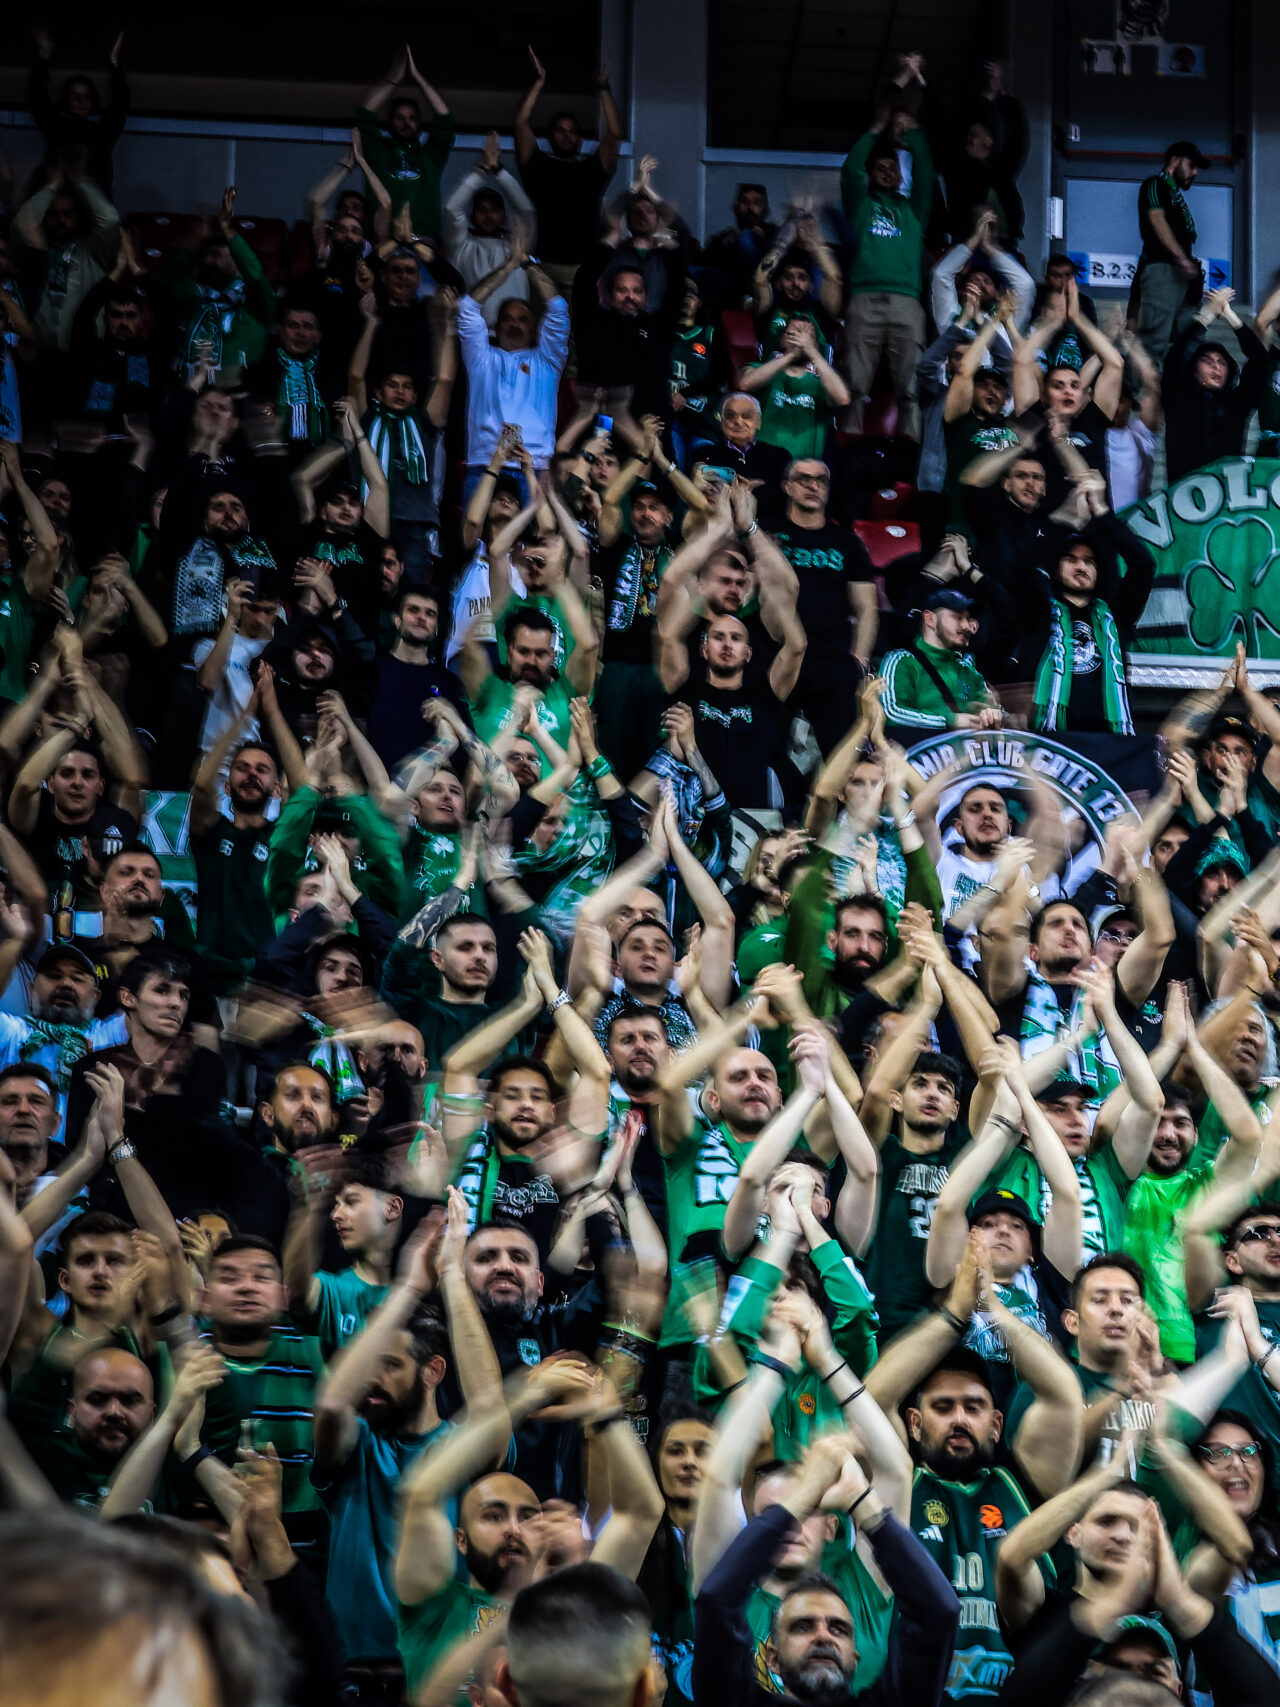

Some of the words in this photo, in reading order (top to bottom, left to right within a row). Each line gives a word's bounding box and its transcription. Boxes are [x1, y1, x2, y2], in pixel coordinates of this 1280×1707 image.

[468, 596, 492, 618] PANA
[910, 743, 962, 782] MIA
[964, 739, 1025, 769] CLUB
[1030, 747, 1099, 797] GATE
[951, 1551, 985, 1592] 10
